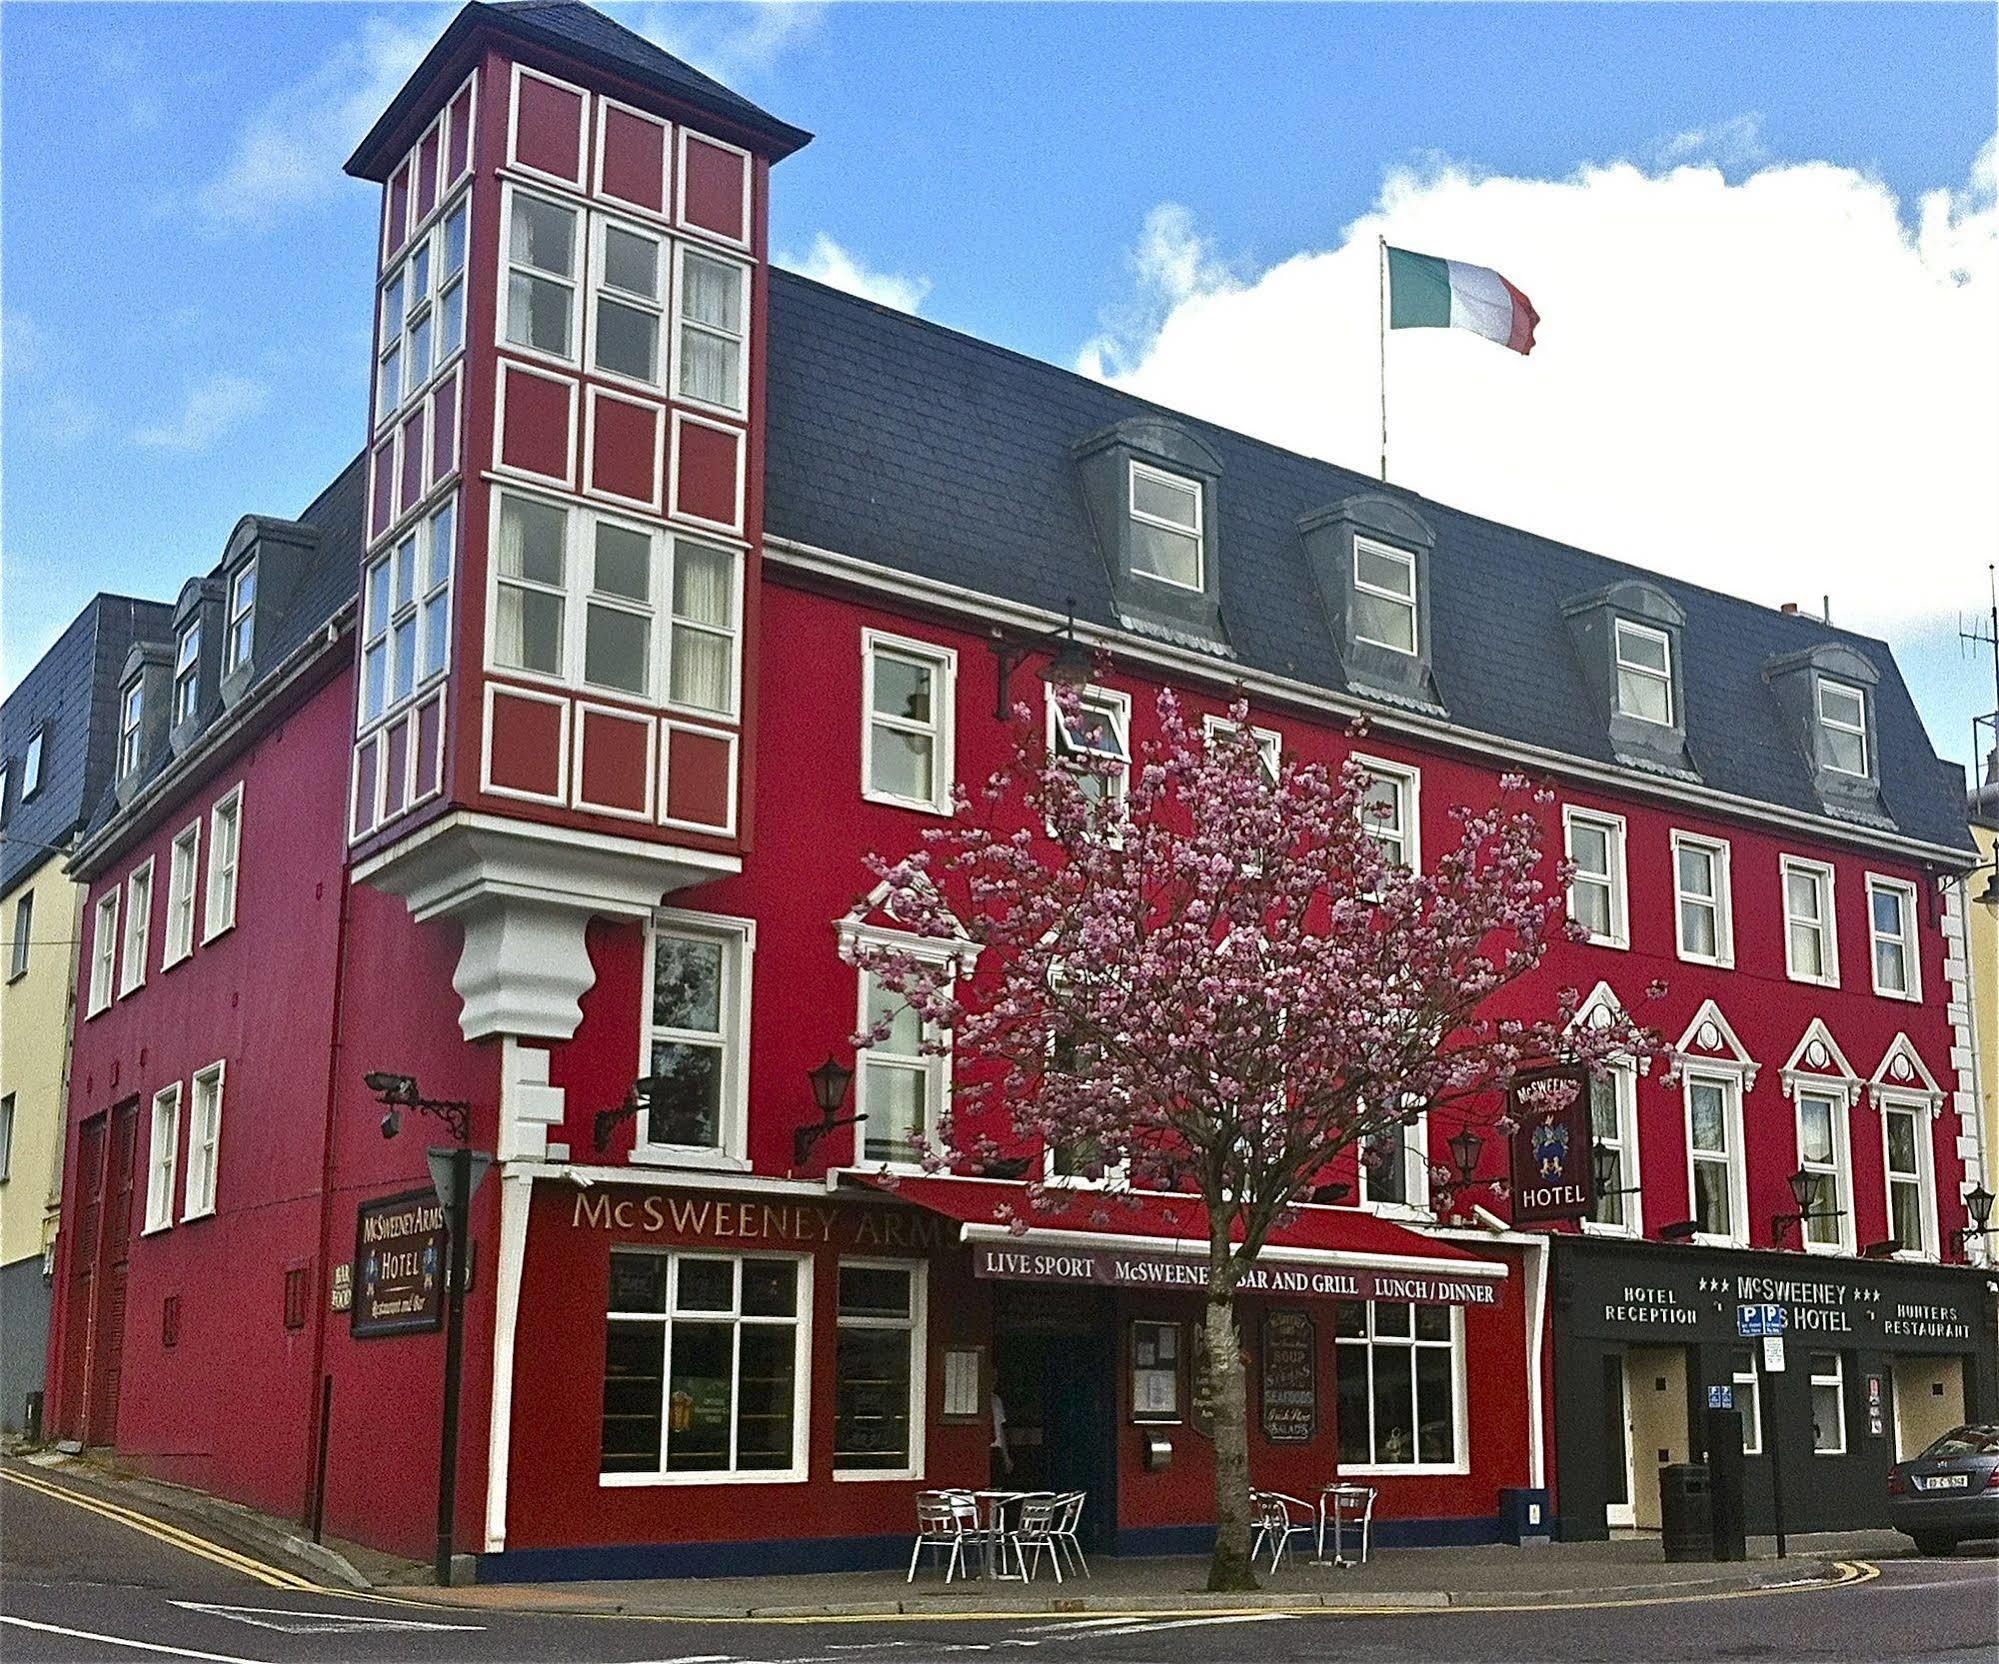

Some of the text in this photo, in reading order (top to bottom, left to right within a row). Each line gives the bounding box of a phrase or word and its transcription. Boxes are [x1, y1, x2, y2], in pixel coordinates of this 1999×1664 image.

[1523, 1185, 1586, 1208] HOTEL
[414, 1206, 443, 1234] ARMS
[572, 1193, 963, 1251] McSWEENEY ARMS
[381, 1251, 419, 1280] HOTEL
[986, 1252, 1094, 1278] LIVE SPORT
[1115, 1261, 1210, 1286] McSWEENE
[1272, 1272, 1309, 1291] AND
[1312, 1274, 1359, 1295] GRILL
[1374, 1278, 1428, 1299] LUNCH
[1438, 1282, 1494, 1303] DINNER
[1624, 1287, 1677, 1304] HOTEL
[1737, 1276, 1846, 1305] McSWEENEY
[1605, 1305, 1697, 1324] RECEPTION
[1744, 1307, 1757, 1322] P
[1767, 1306, 1777, 1322] P
[1794, 1307, 1852, 1331] HOTEL
[1897, 1304, 1958, 1321] HUNTERS
[1884, 1321, 1970, 1338] RESTAURANT
